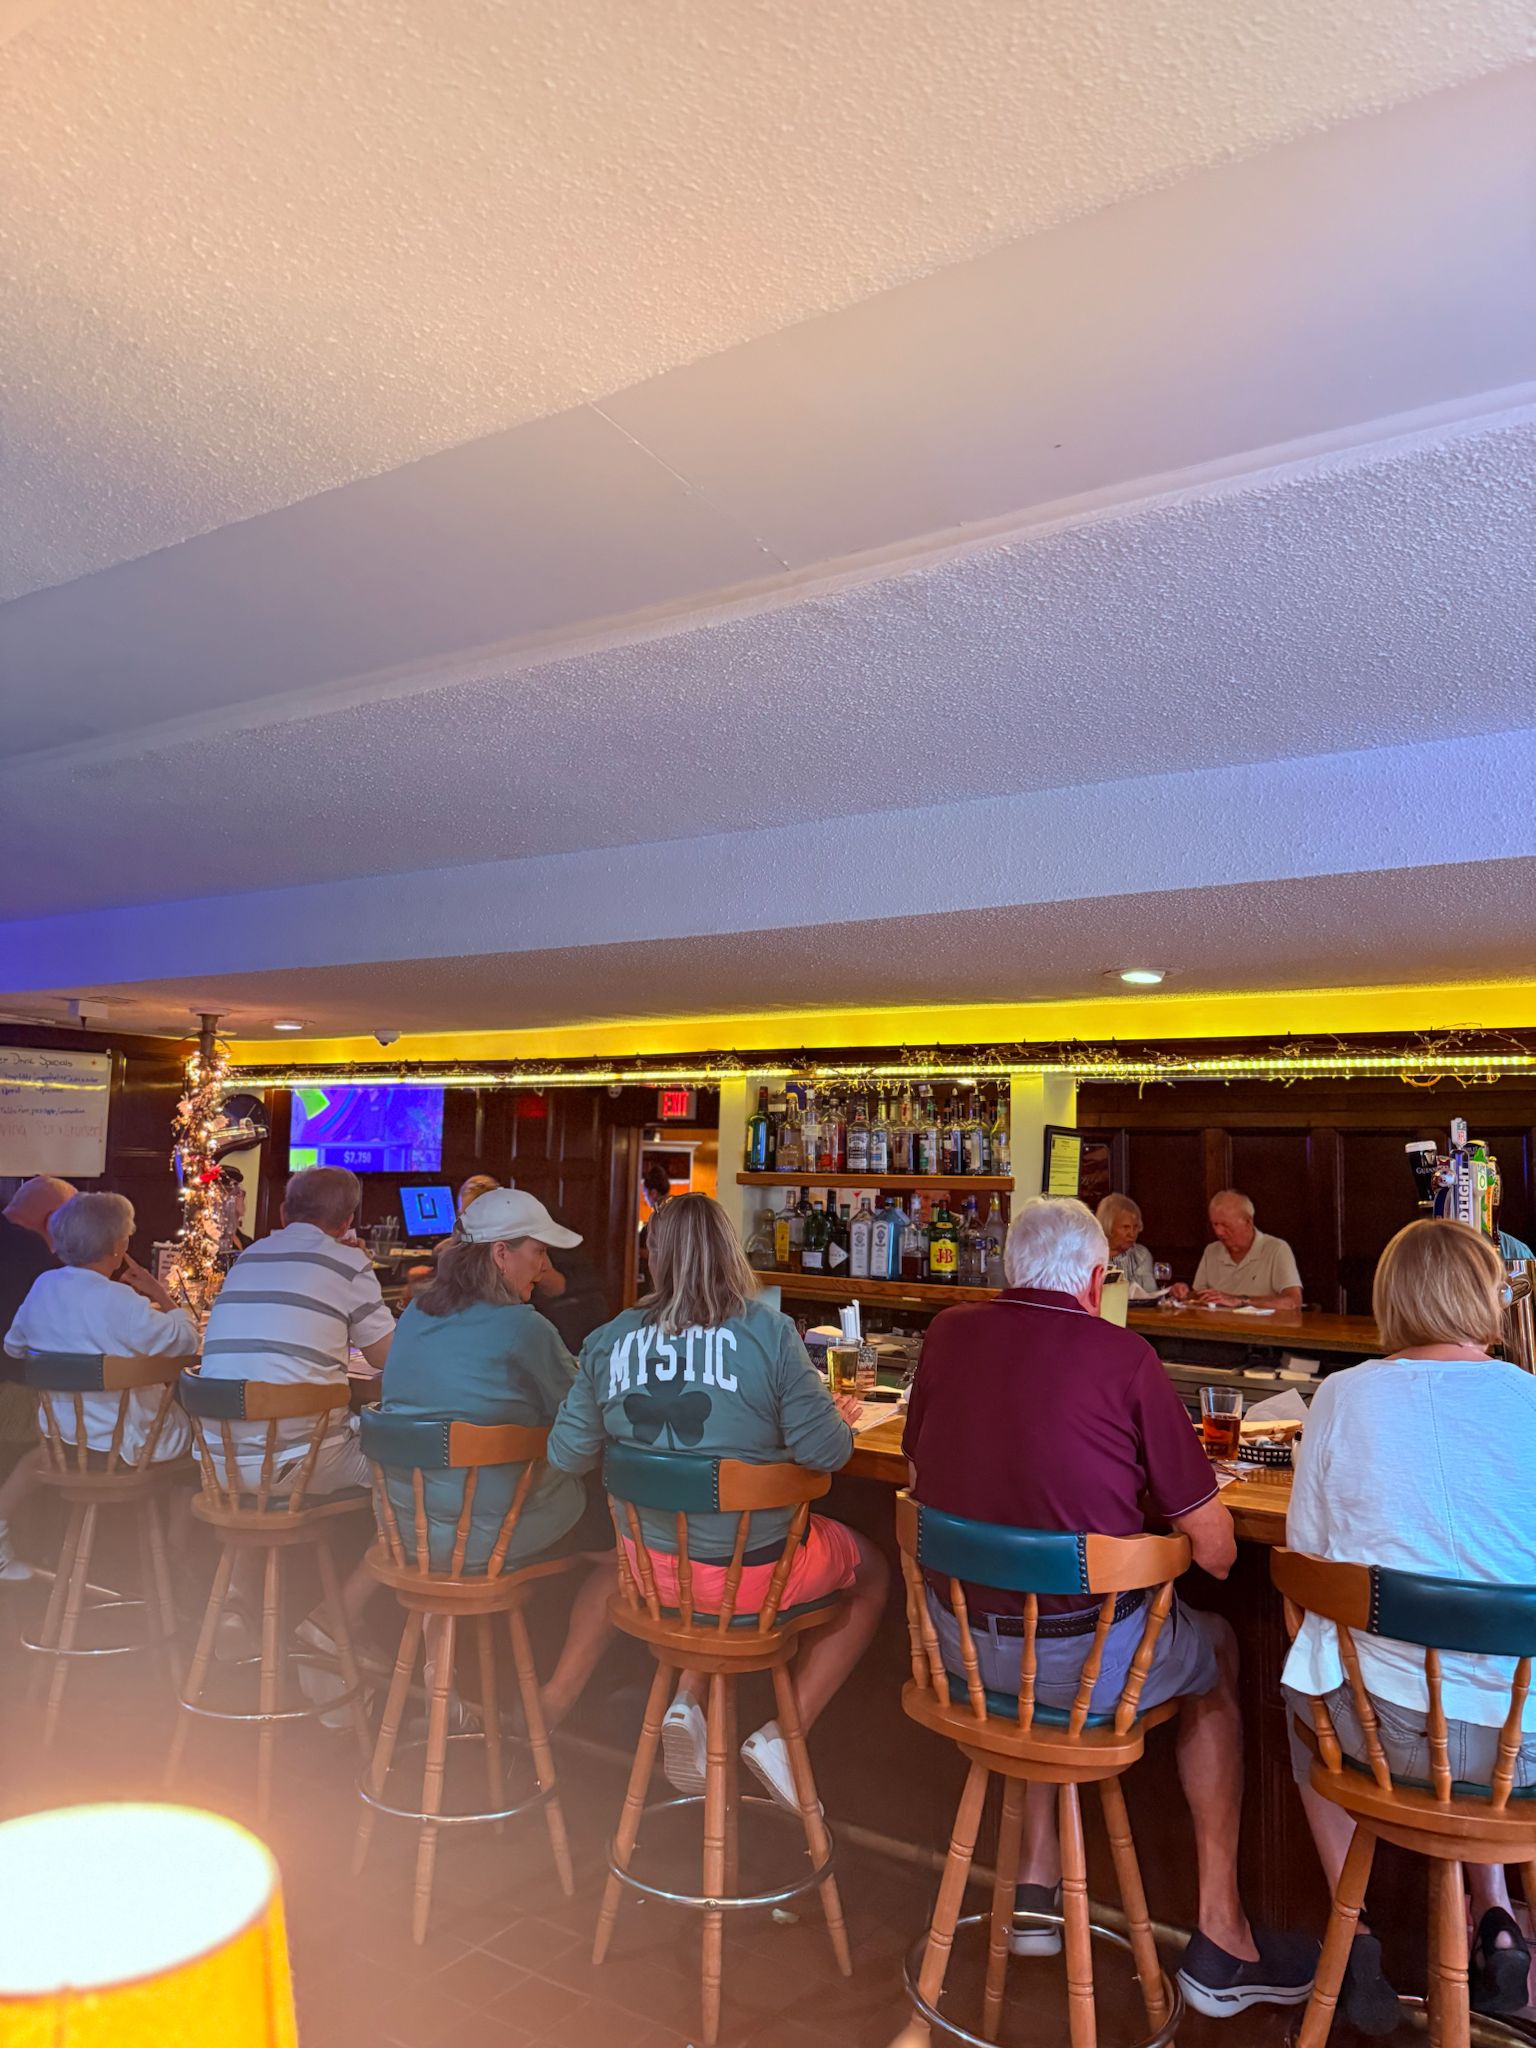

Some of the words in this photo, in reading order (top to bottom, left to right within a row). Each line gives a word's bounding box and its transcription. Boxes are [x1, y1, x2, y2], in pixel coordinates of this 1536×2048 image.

[663, 1091, 689, 1117] EXIT
[1458, 1166, 1469, 1210] LIGHT
[608, 1324, 738, 1400] MYSTIC
